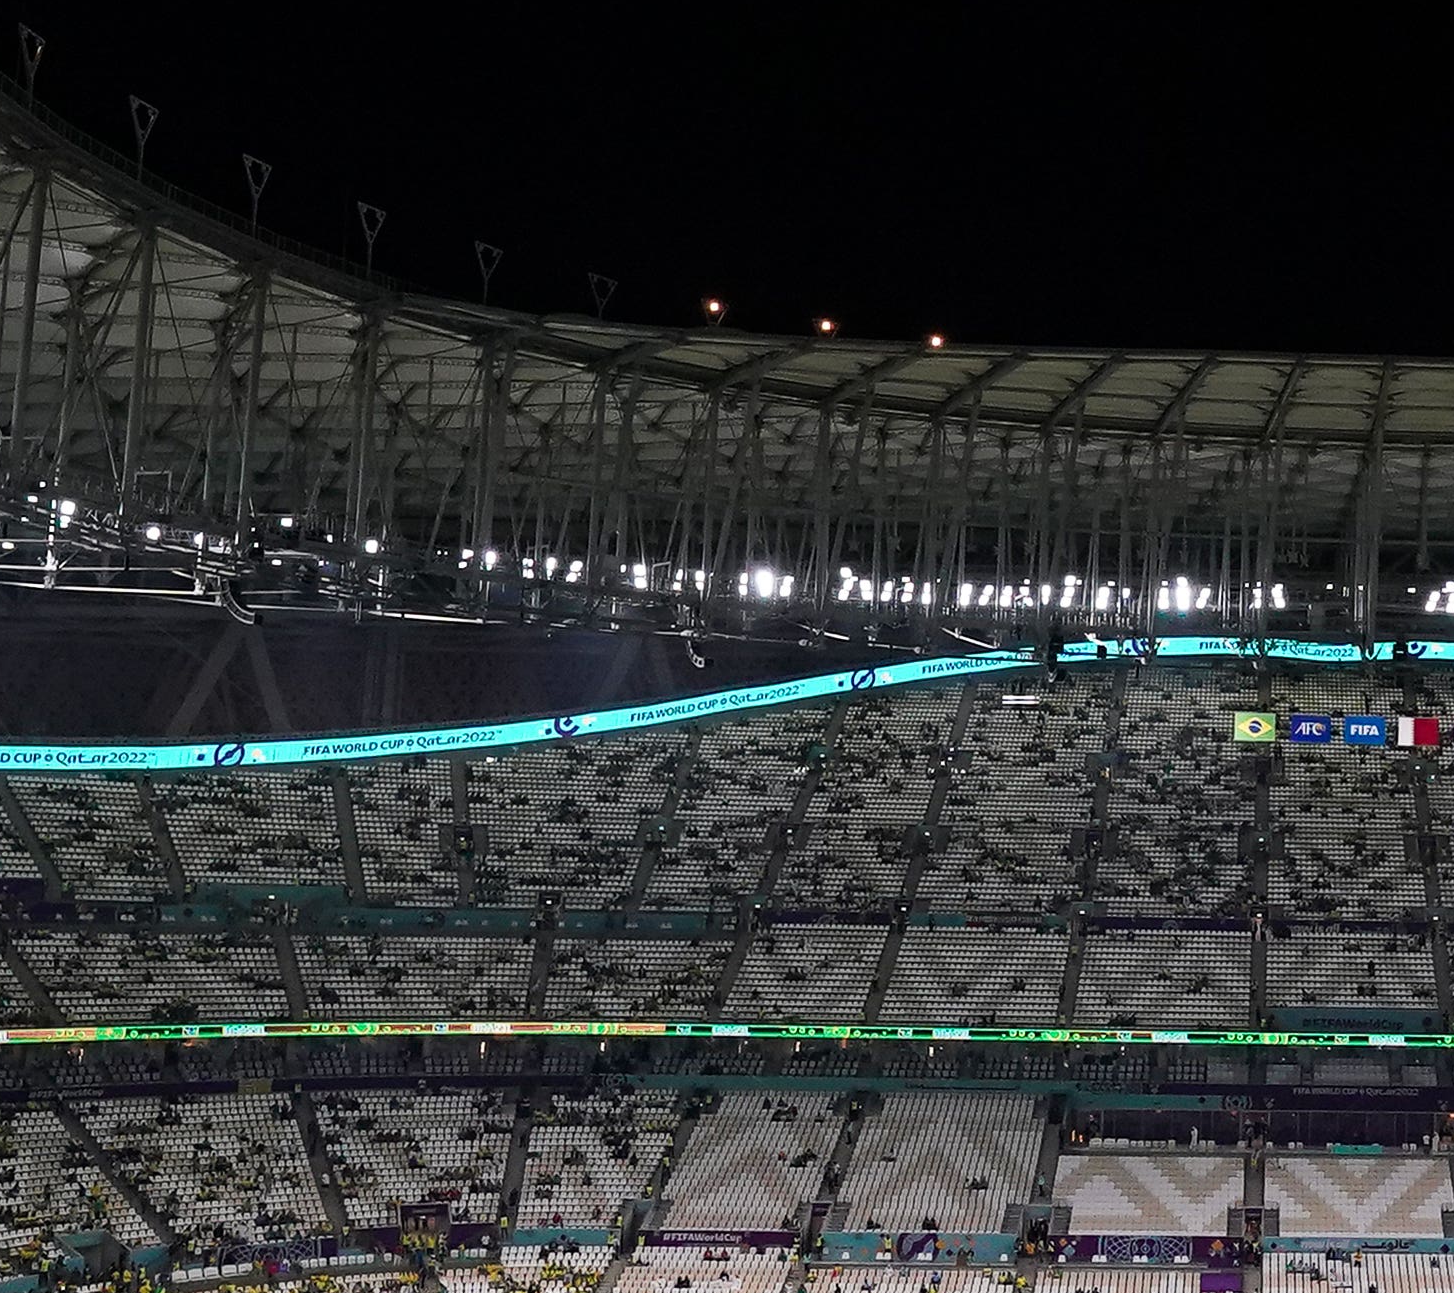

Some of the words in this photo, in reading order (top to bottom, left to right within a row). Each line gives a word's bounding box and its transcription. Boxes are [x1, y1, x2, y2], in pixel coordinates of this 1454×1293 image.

[630, 712, 655, 722] FIFA
[656, 703, 696, 718] WORLD
[697, 699, 718, 711] CUP
[1295, 722, 1324, 736] AFC
[1350, 725, 1380, 736] FIFA
[303, 745, 334, 757] FIFA
[334, 742, 378, 755] WORLD
[380, 739, 404, 750] CUP
[14, 752, 41, 764] CUP
[663, 1232, 743, 1244] #FIFAWorldCup
